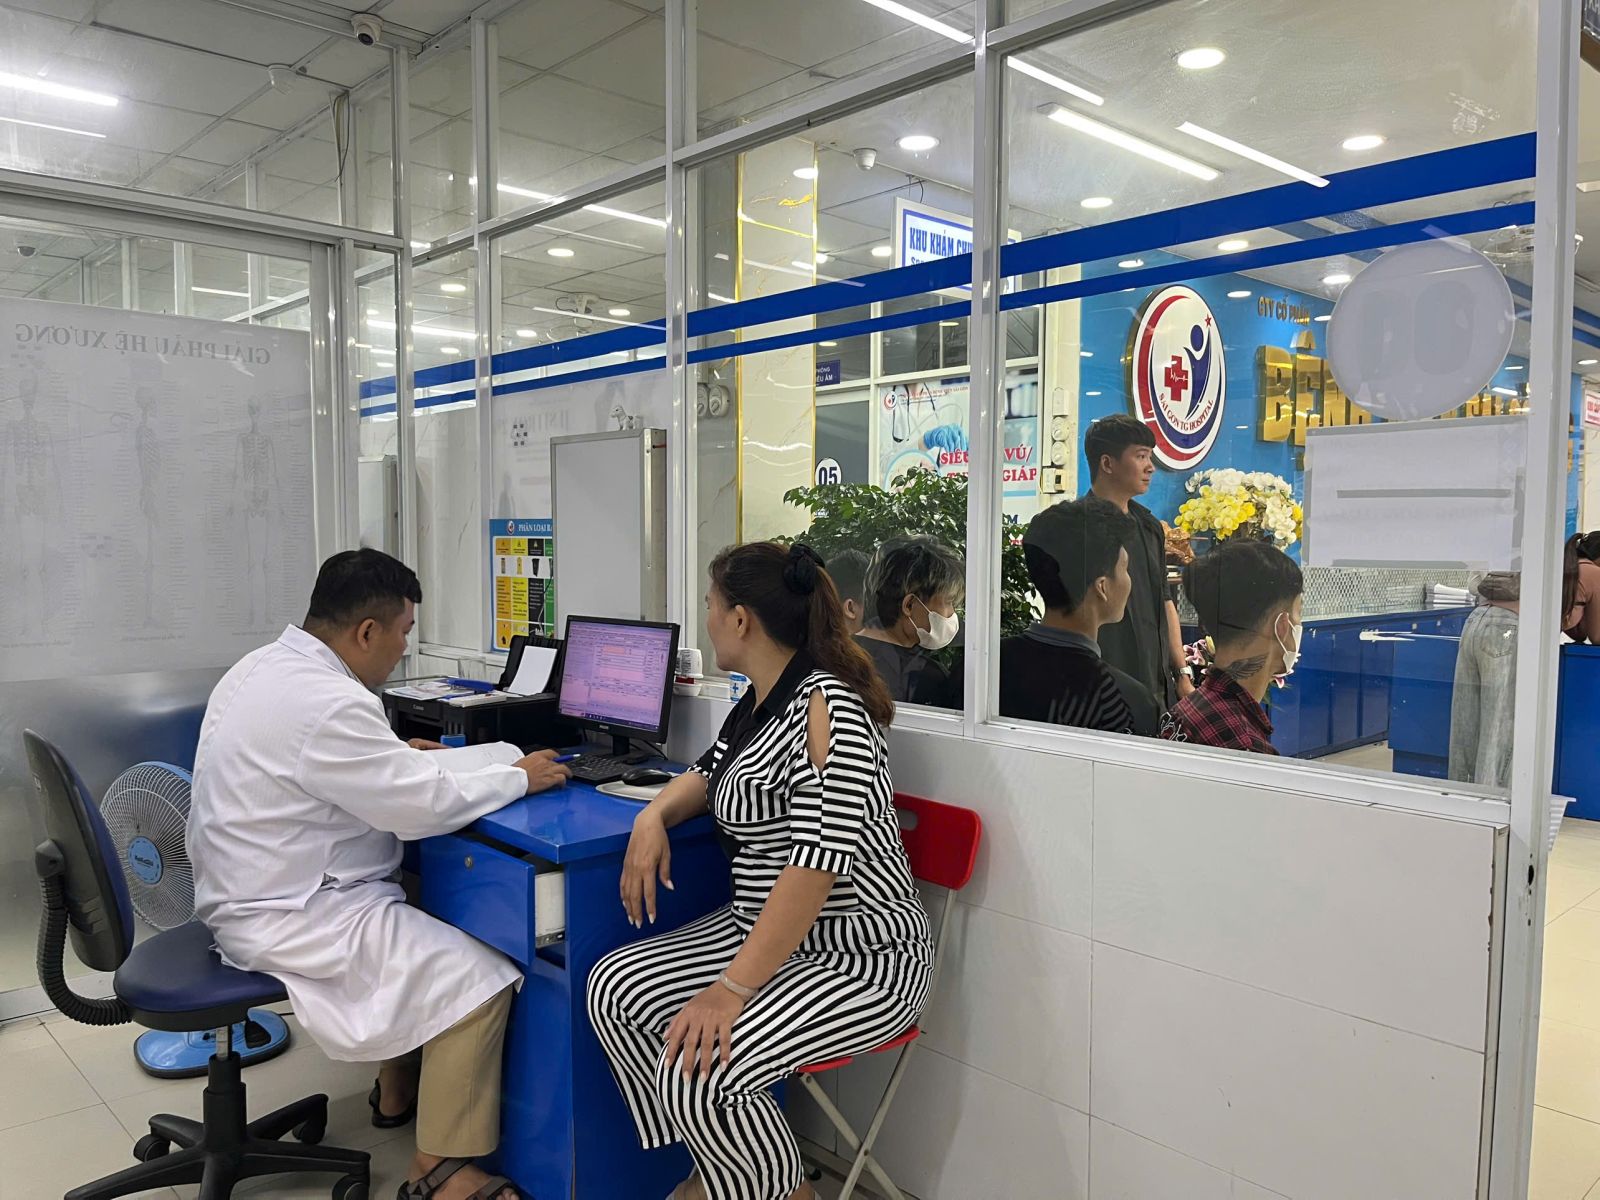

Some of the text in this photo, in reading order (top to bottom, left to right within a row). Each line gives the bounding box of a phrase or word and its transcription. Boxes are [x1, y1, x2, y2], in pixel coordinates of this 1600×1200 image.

[909, 227, 928, 252] KHU
[930, 229, 954, 257] KHÁM
[818, 466, 838, 486] 05
[1003, 465, 1037, 482] GIÁP
